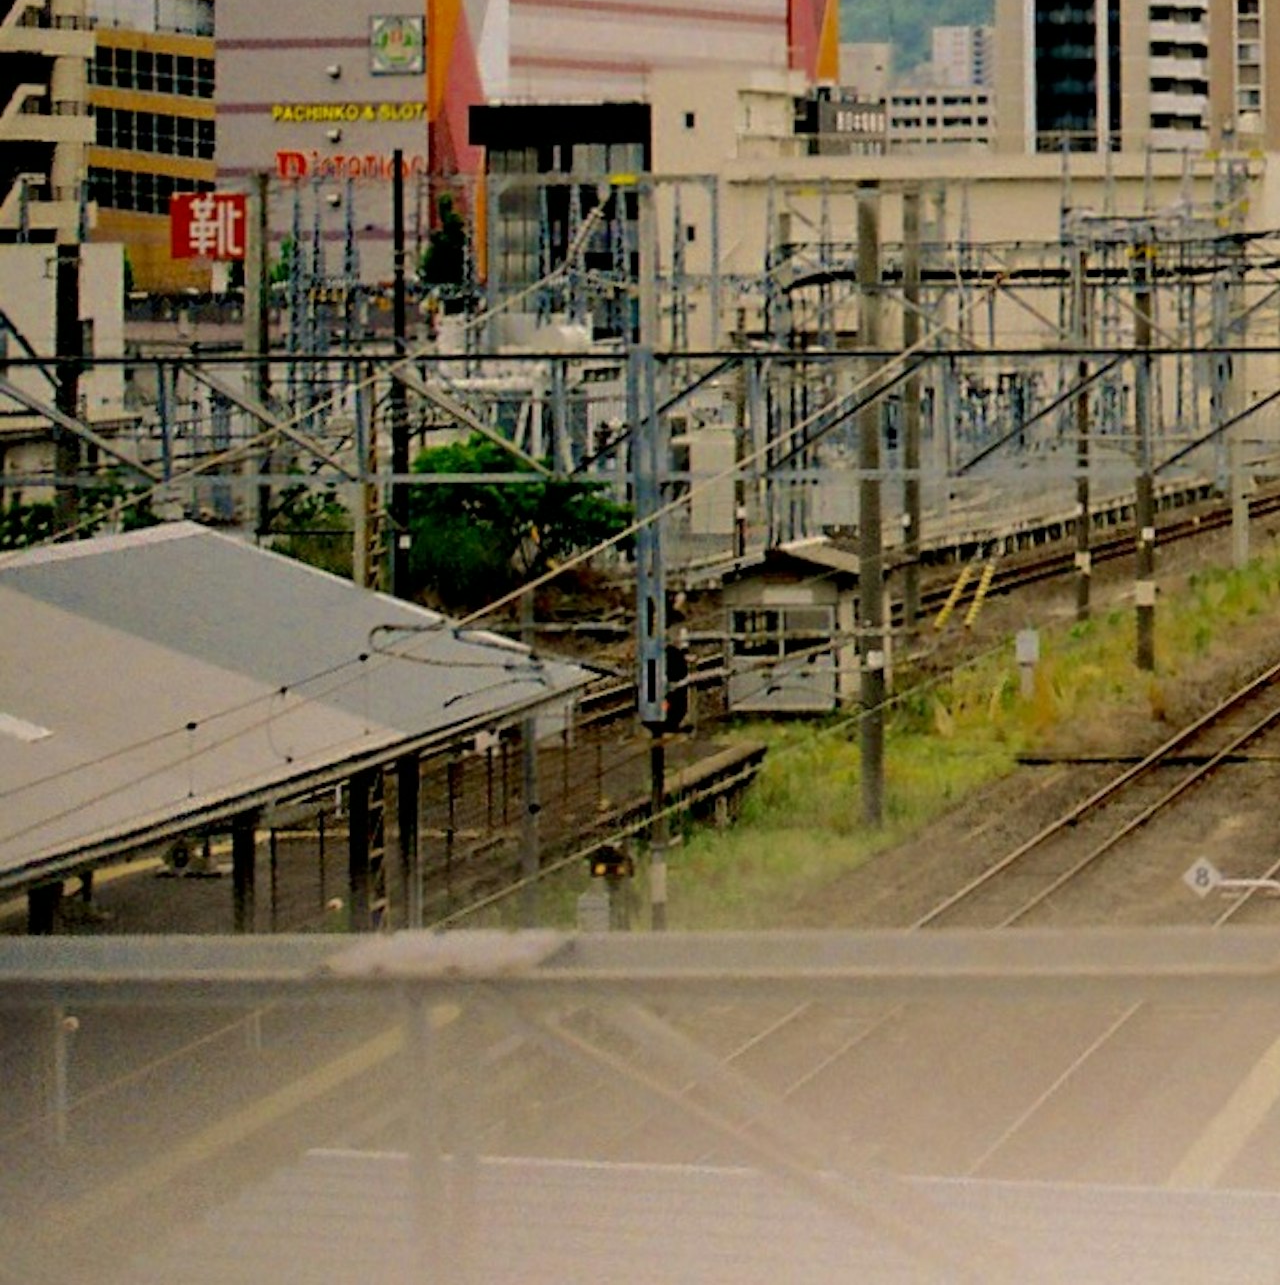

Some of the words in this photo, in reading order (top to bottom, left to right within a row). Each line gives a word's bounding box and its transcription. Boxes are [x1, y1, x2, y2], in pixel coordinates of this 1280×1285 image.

[272, 104, 359, 121] PACHINKO
[364, 105, 376, 121] &
[379, 103, 425, 121] SLOT
[188, 193, 244, 257] 靴
[1195, 867, 1210, 887] 8
